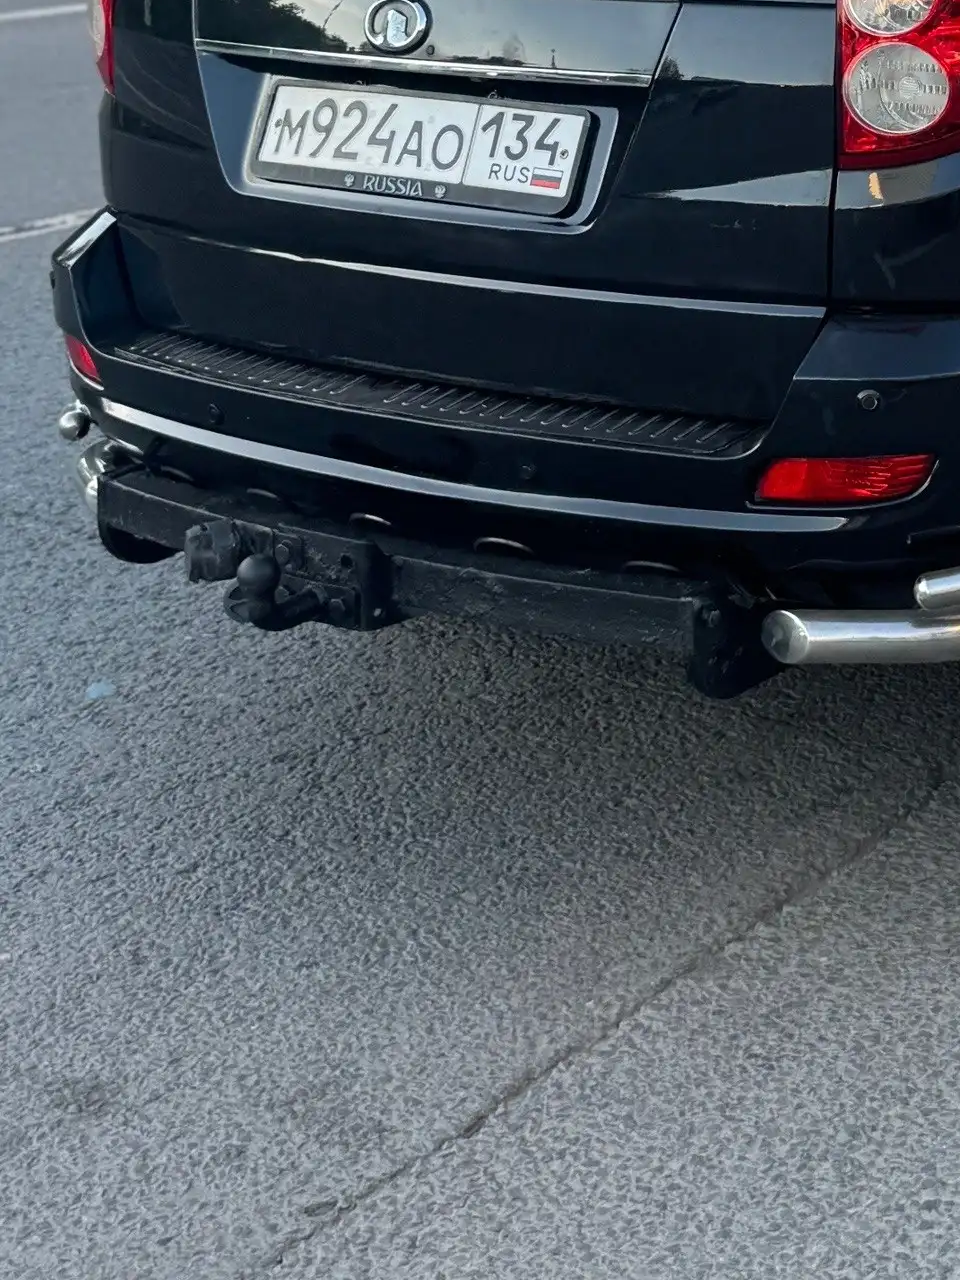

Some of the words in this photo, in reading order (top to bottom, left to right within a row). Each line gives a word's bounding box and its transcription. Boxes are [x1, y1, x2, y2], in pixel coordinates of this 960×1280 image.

[481, 111, 561, 166] 134
[488, 162, 530, 184] RUS
[362, 176, 423, 198] RUSSIA
